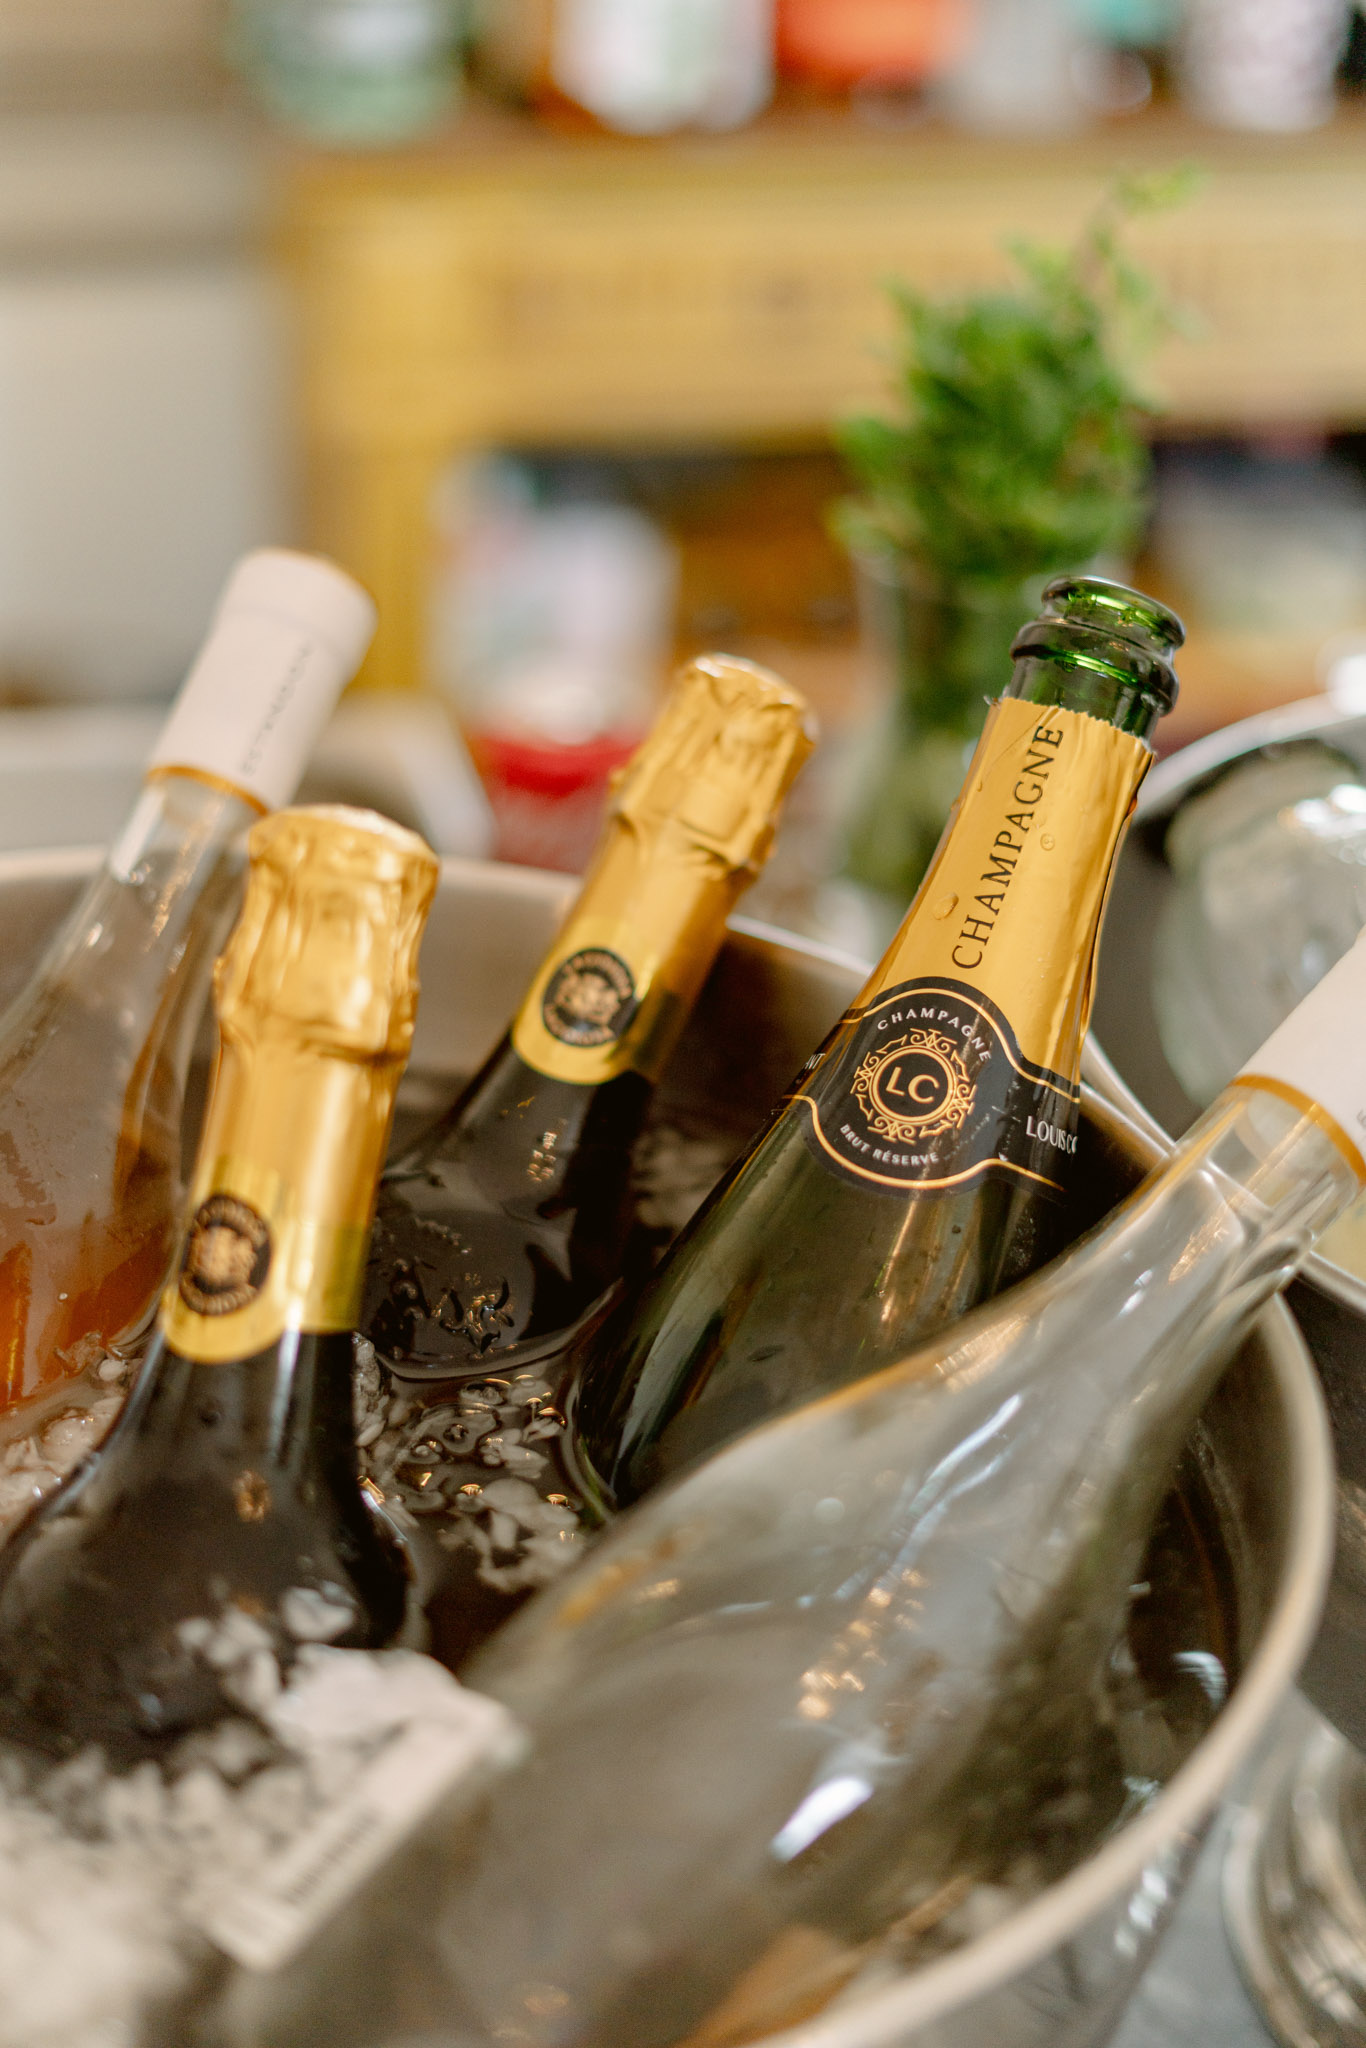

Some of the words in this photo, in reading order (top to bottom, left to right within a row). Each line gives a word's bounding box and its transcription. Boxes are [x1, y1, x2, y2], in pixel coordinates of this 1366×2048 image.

[951, 725, 1064, 969] CHAMPAGNE
[877, 1007, 992, 1062] CHAMPAGNE
[885, 1066, 940, 1104] LC
[839, 1124, 871, 1153] BRUT
[872, 1149, 940, 1166] RÉSERVE
[1026, 1115, 1066, 1151] LOUIS
